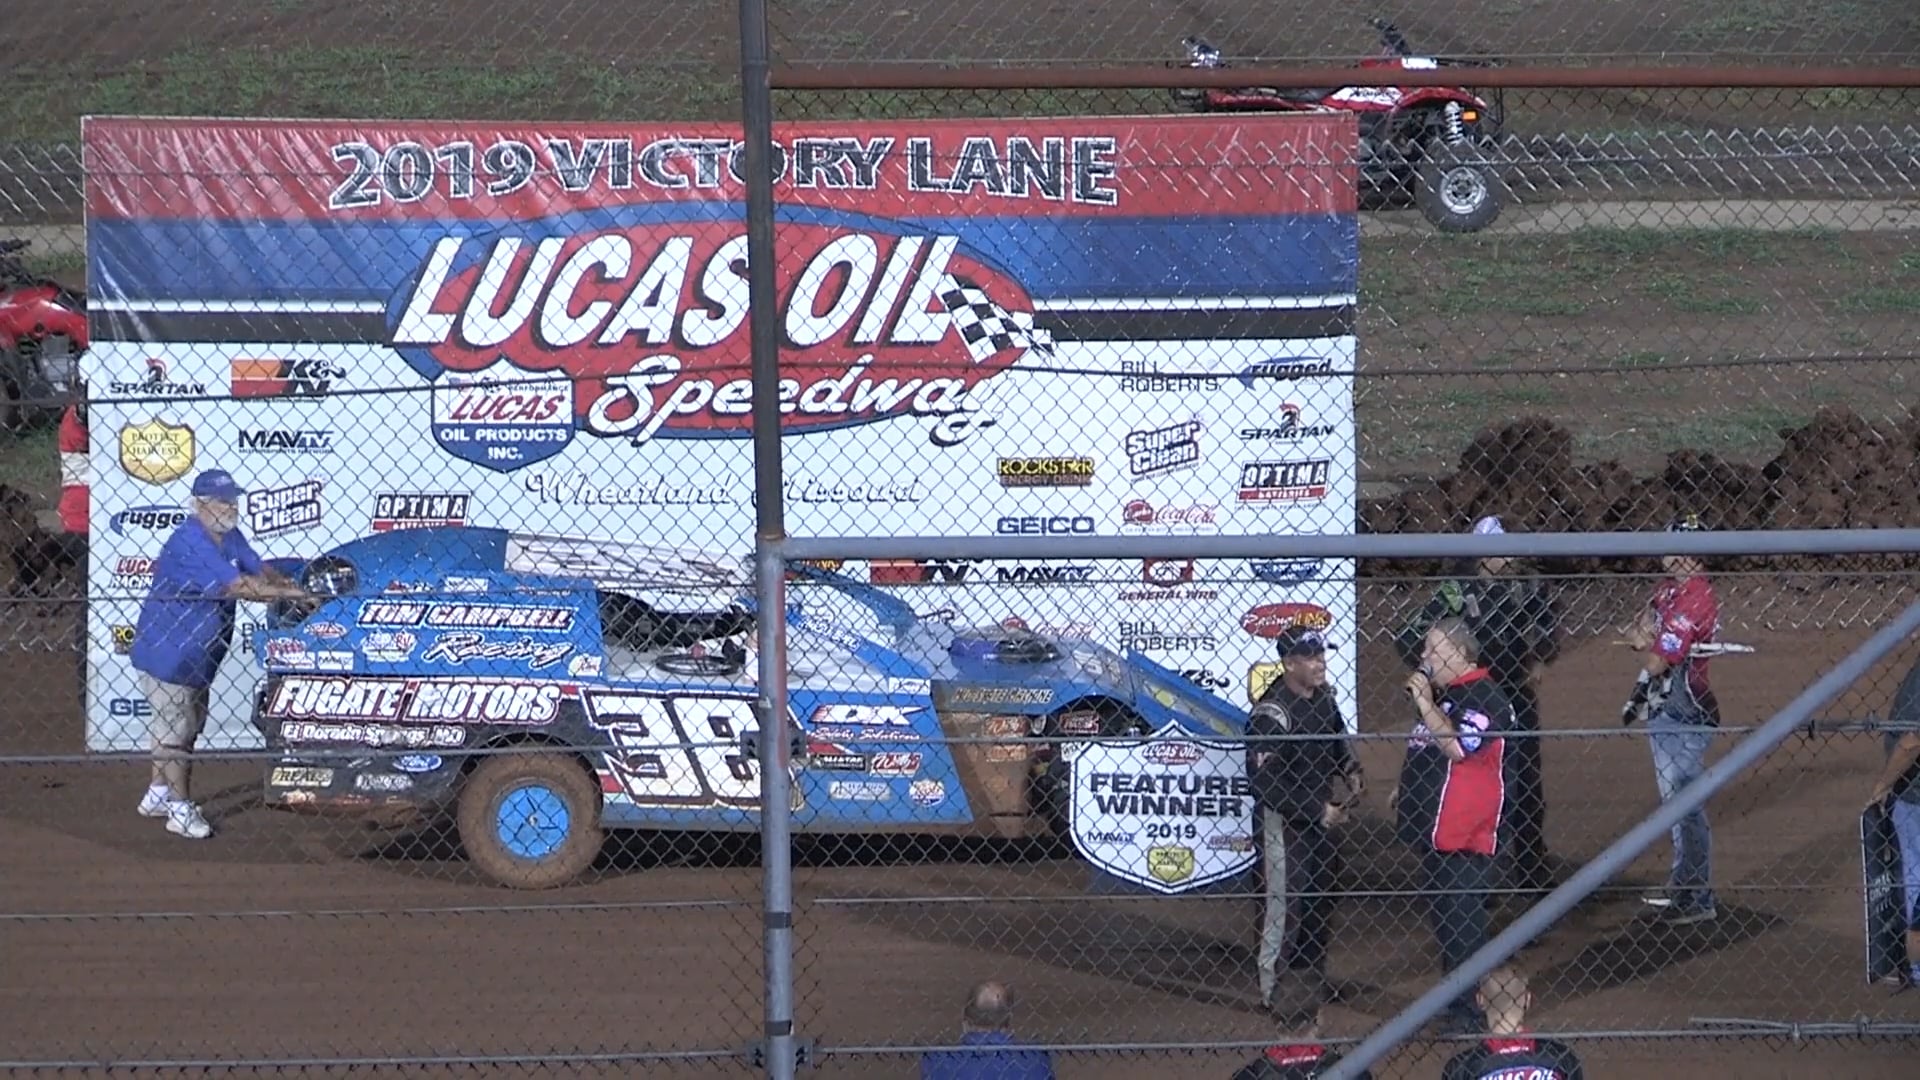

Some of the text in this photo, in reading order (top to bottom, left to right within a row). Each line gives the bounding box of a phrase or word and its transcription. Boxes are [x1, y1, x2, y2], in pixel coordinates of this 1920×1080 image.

[329, 136, 1119, 209] 2019 VICTORY LANE
[391, 234, 959, 347] LUCAS OIL
[110, 382, 204, 394] SPARTAN
[1121, 378, 1217, 391] ROBERTS
[451, 395, 565, 420] LUCAS
[586, 354, 1010, 447] Speedway
[440, 428, 568, 442] OIL PRODUCTS
[1128, 425, 1196, 451] Super
[1239, 426, 1335, 440] SPARTAN
[488, 447, 524, 460] INC.
[1133, 446, 1196, 473] Clean
[1244, 463, 1326, 486] OPTIMA
[250, 484, 320, 513] Super
[377, 494, 464, 517] OPTIMA
[121, 510, 186, 530] rugge
[255, 503, 320, 534] Clean
[997, 516, 1095, 534] GEICO
[117, 559, 158, 573] LUCA
[1119, 622, 1160, 635] BILL
[1120, 637, 1215, 651] ROBERTS
[270, 680, 559, 721] FUGATE MOTORS
[1090, 773, 1250, 796] FEATURE
[1094, 795, 1243, 817] WINNER
[1146, 823, 1197, 839] 2019
